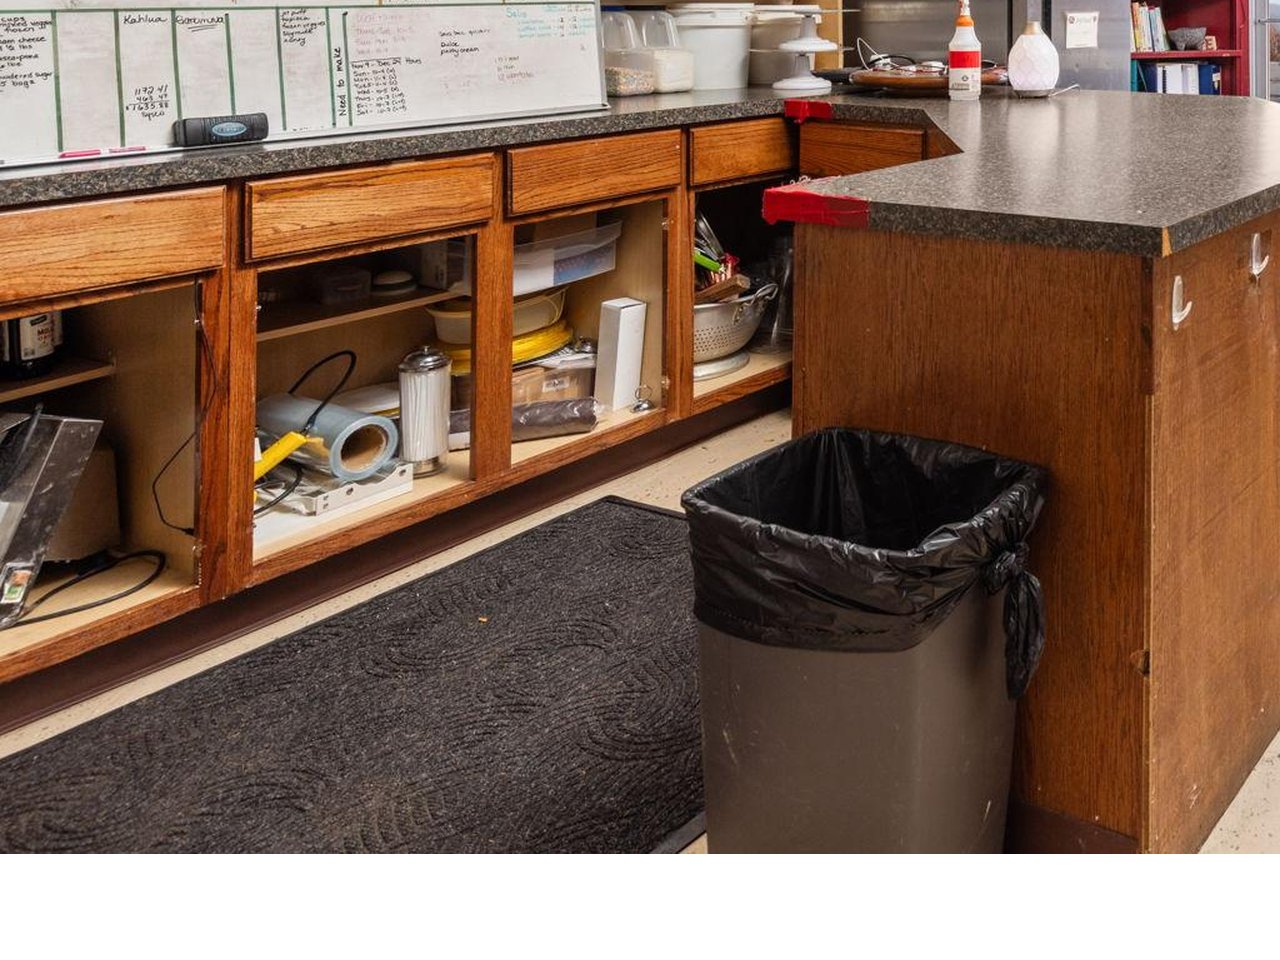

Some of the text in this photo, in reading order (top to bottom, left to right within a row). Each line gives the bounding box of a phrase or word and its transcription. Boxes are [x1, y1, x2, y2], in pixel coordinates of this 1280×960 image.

[334, 46, 347, 116] Need to make
